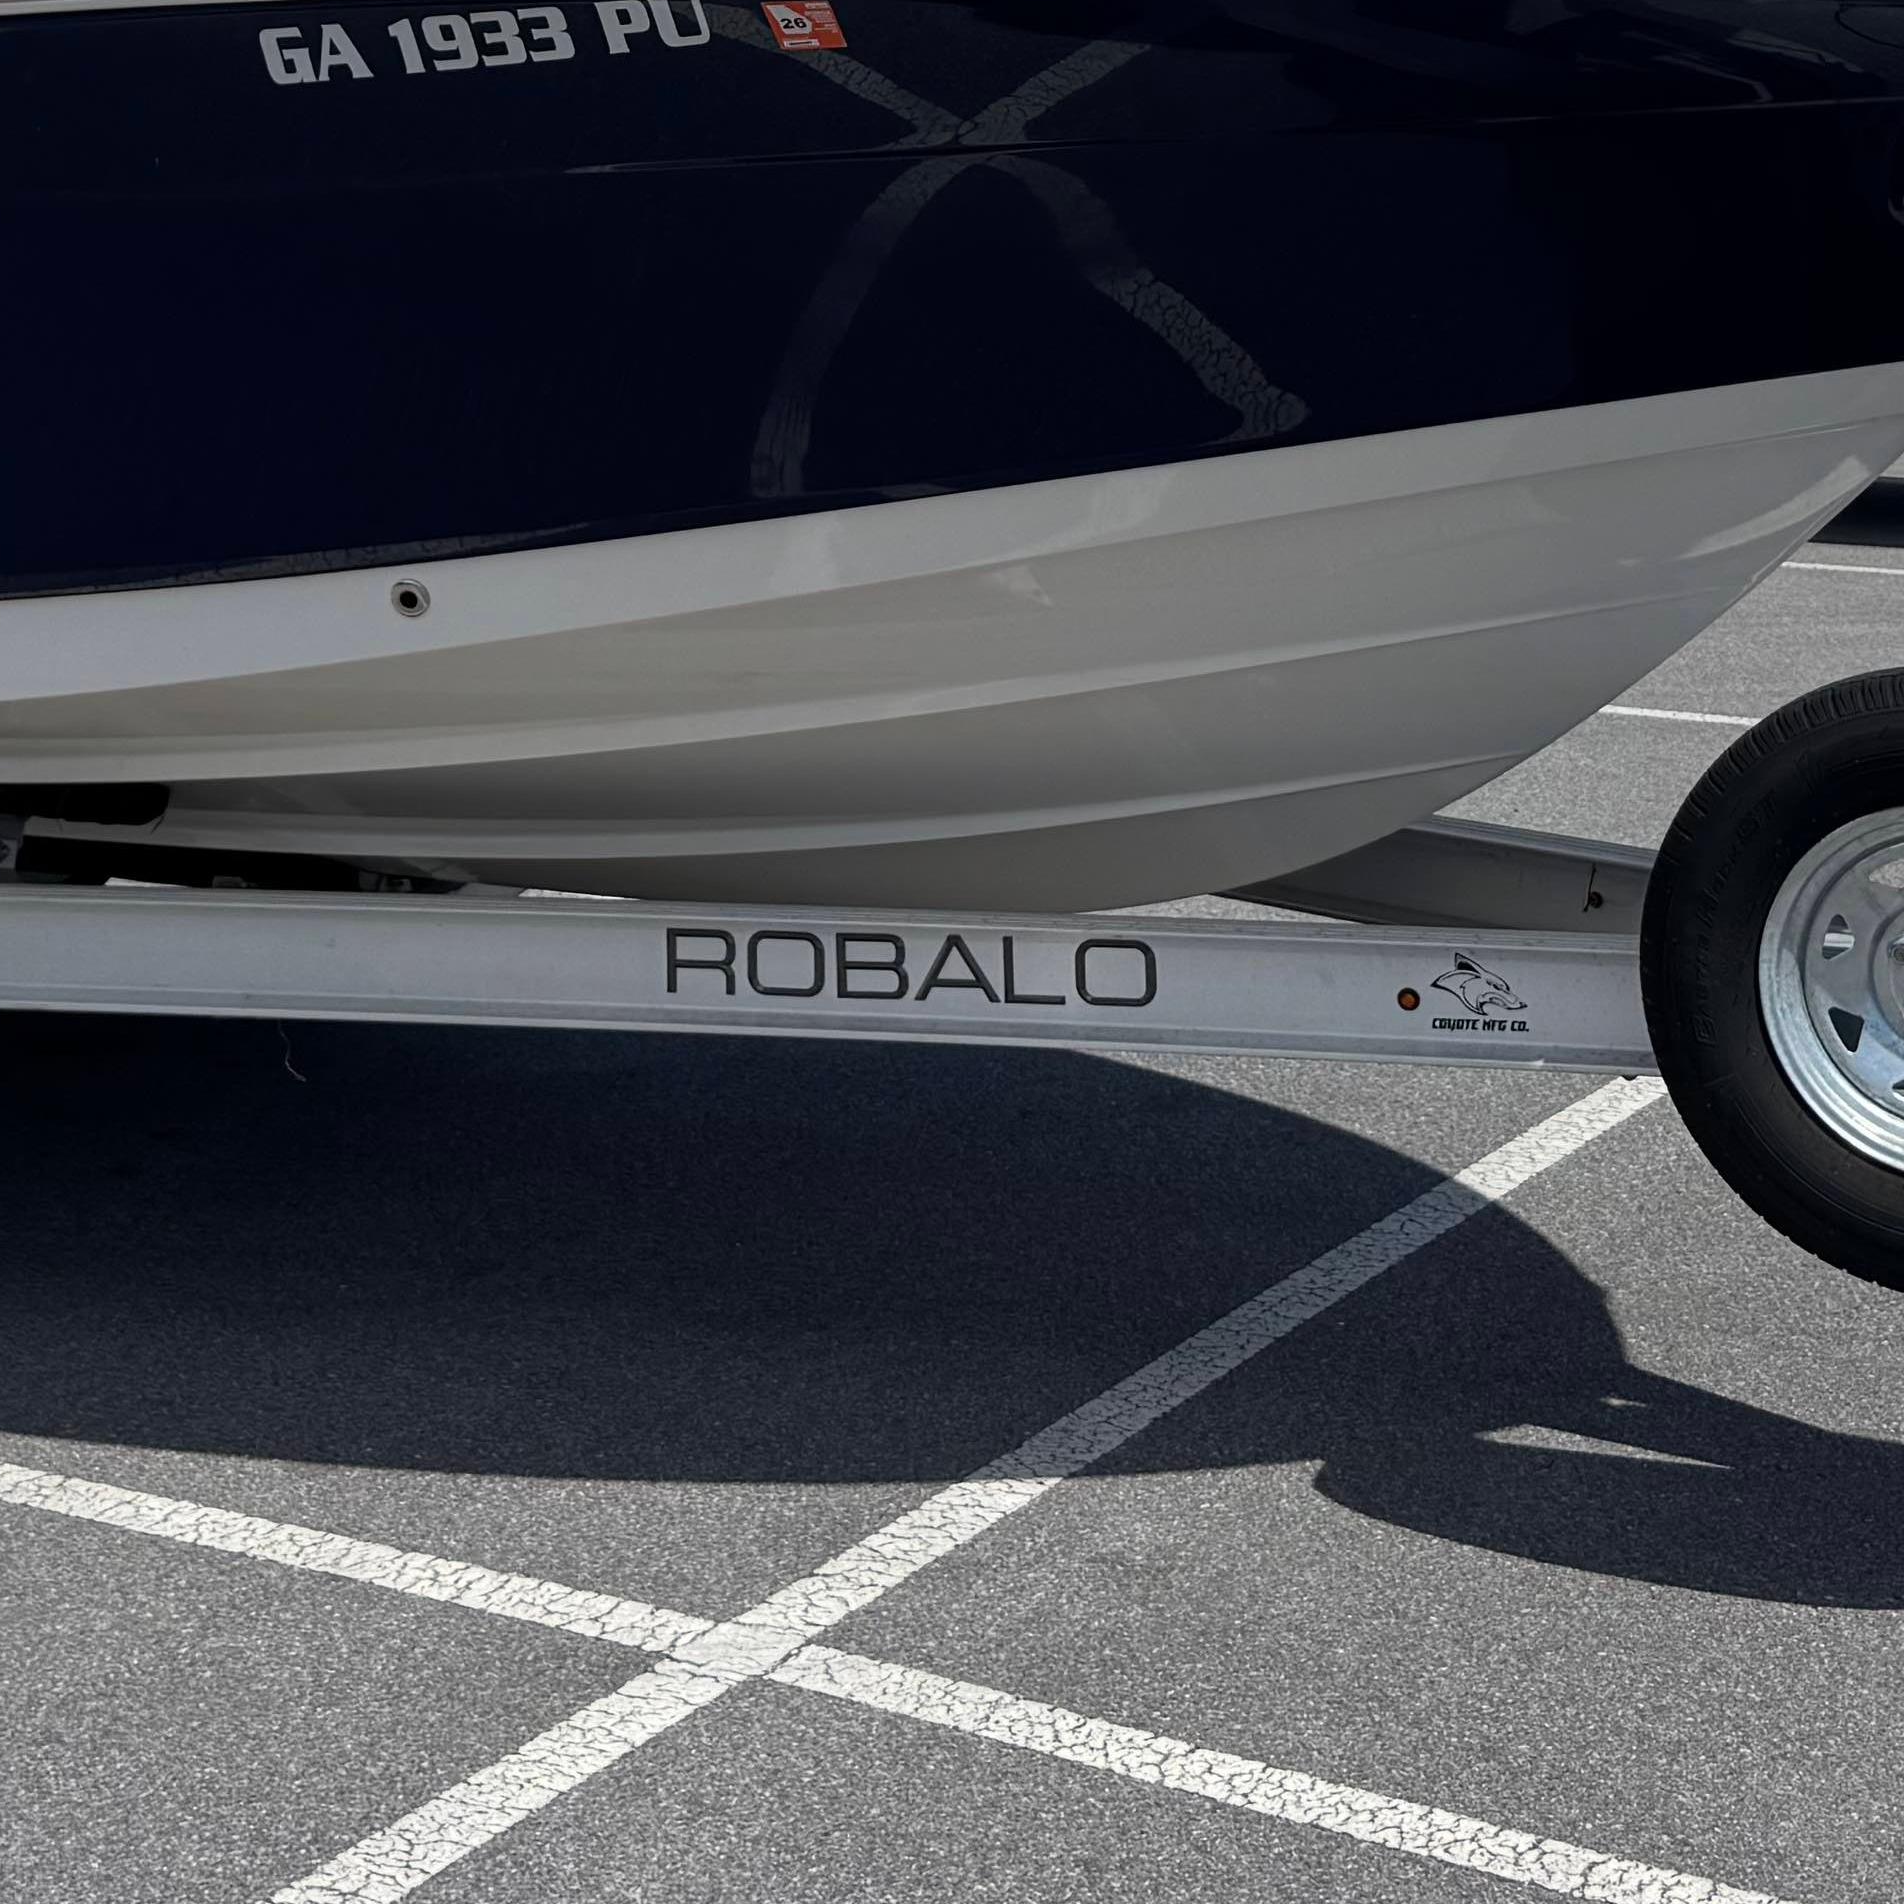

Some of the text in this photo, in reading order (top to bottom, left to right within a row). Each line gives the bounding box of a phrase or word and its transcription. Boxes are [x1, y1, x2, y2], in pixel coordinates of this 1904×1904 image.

[259, 23, 374, 85] GA
[388, 6, 576, 74] 1933
[780, 16, 807, 29] 26
[666, 927, 1158, 1007] ROBALO
[1432, 1017, 1530, 1033] COYOTE MFG CO.
